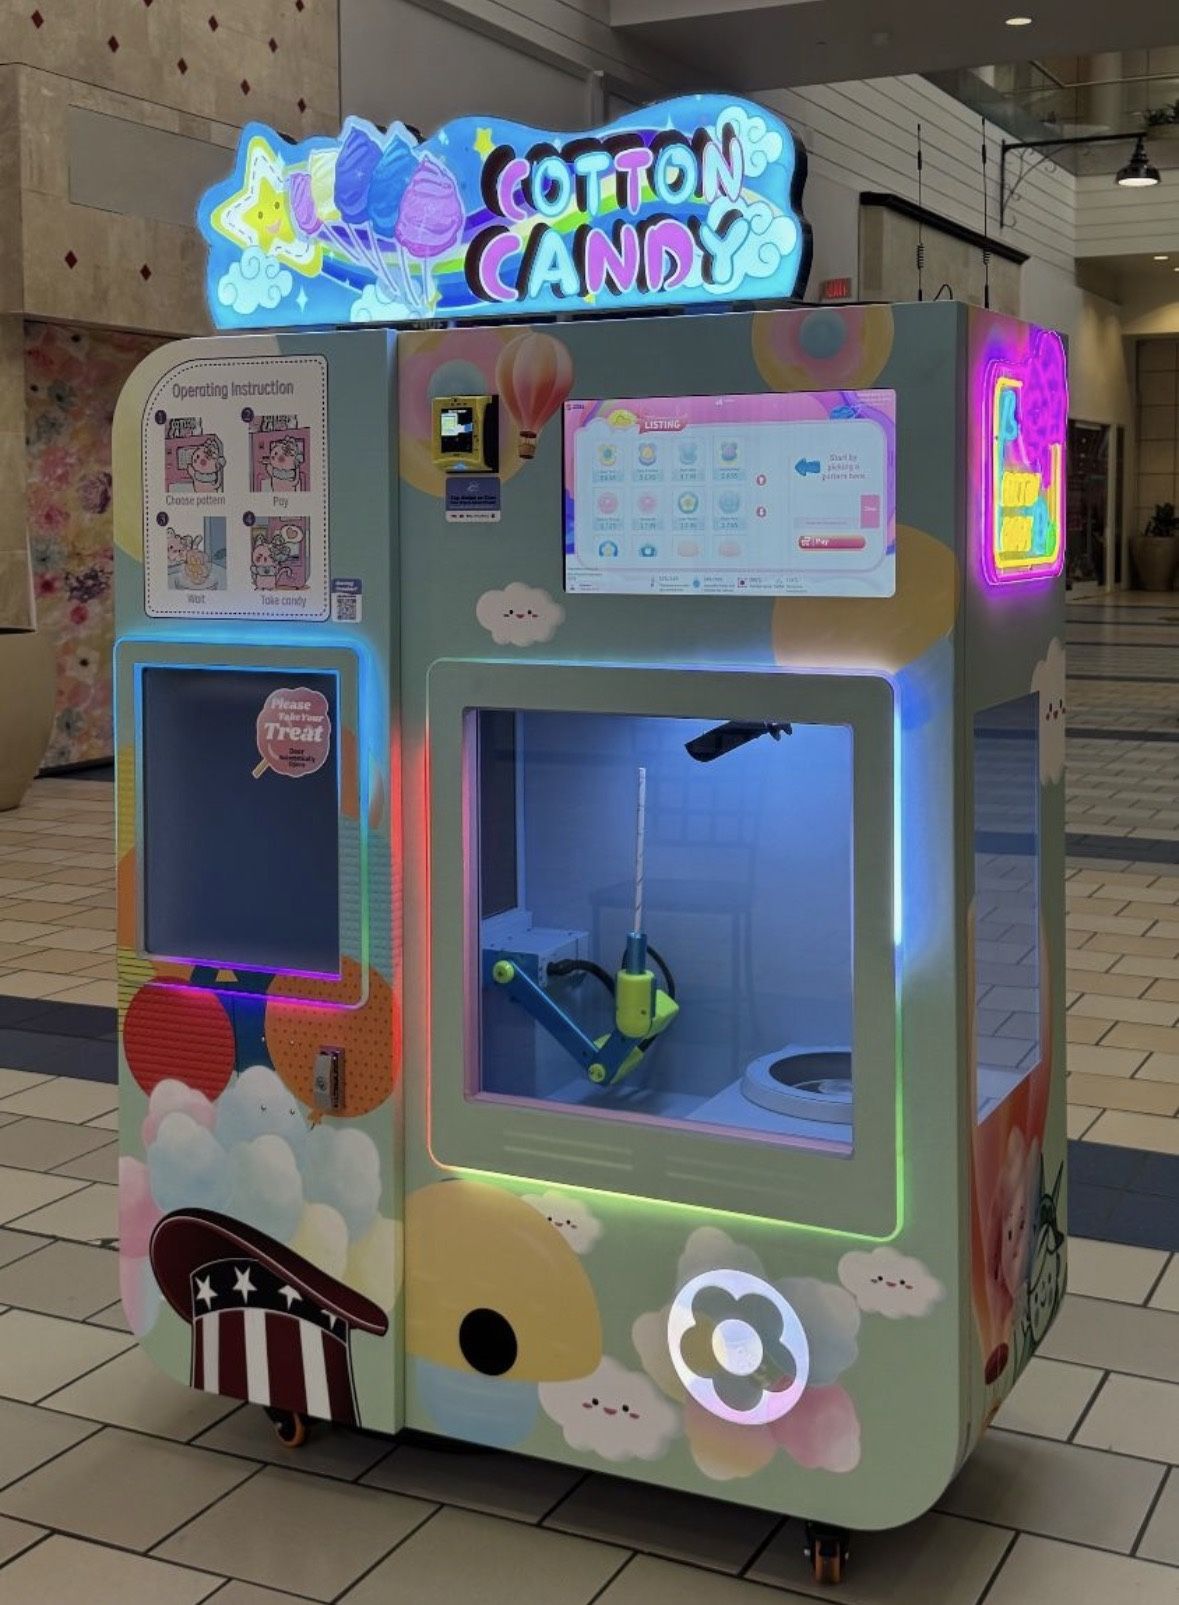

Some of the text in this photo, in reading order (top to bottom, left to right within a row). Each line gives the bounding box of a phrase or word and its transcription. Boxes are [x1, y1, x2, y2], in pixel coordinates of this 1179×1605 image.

[496, 138, 743, 221] COTTON
[479, 215, 751, 300] CANDY
[172, 379, 294, 400] Operating Instruction
[644, 420, 681, 430] LISTING
[165, 494, 226, 507] Choose pattern
[272, 495, 289, 508] Pay
[261, 594, 307, 608] Take candy
[271, 698, 311, 711] Please
[264, 722, 323, 742] Treat
